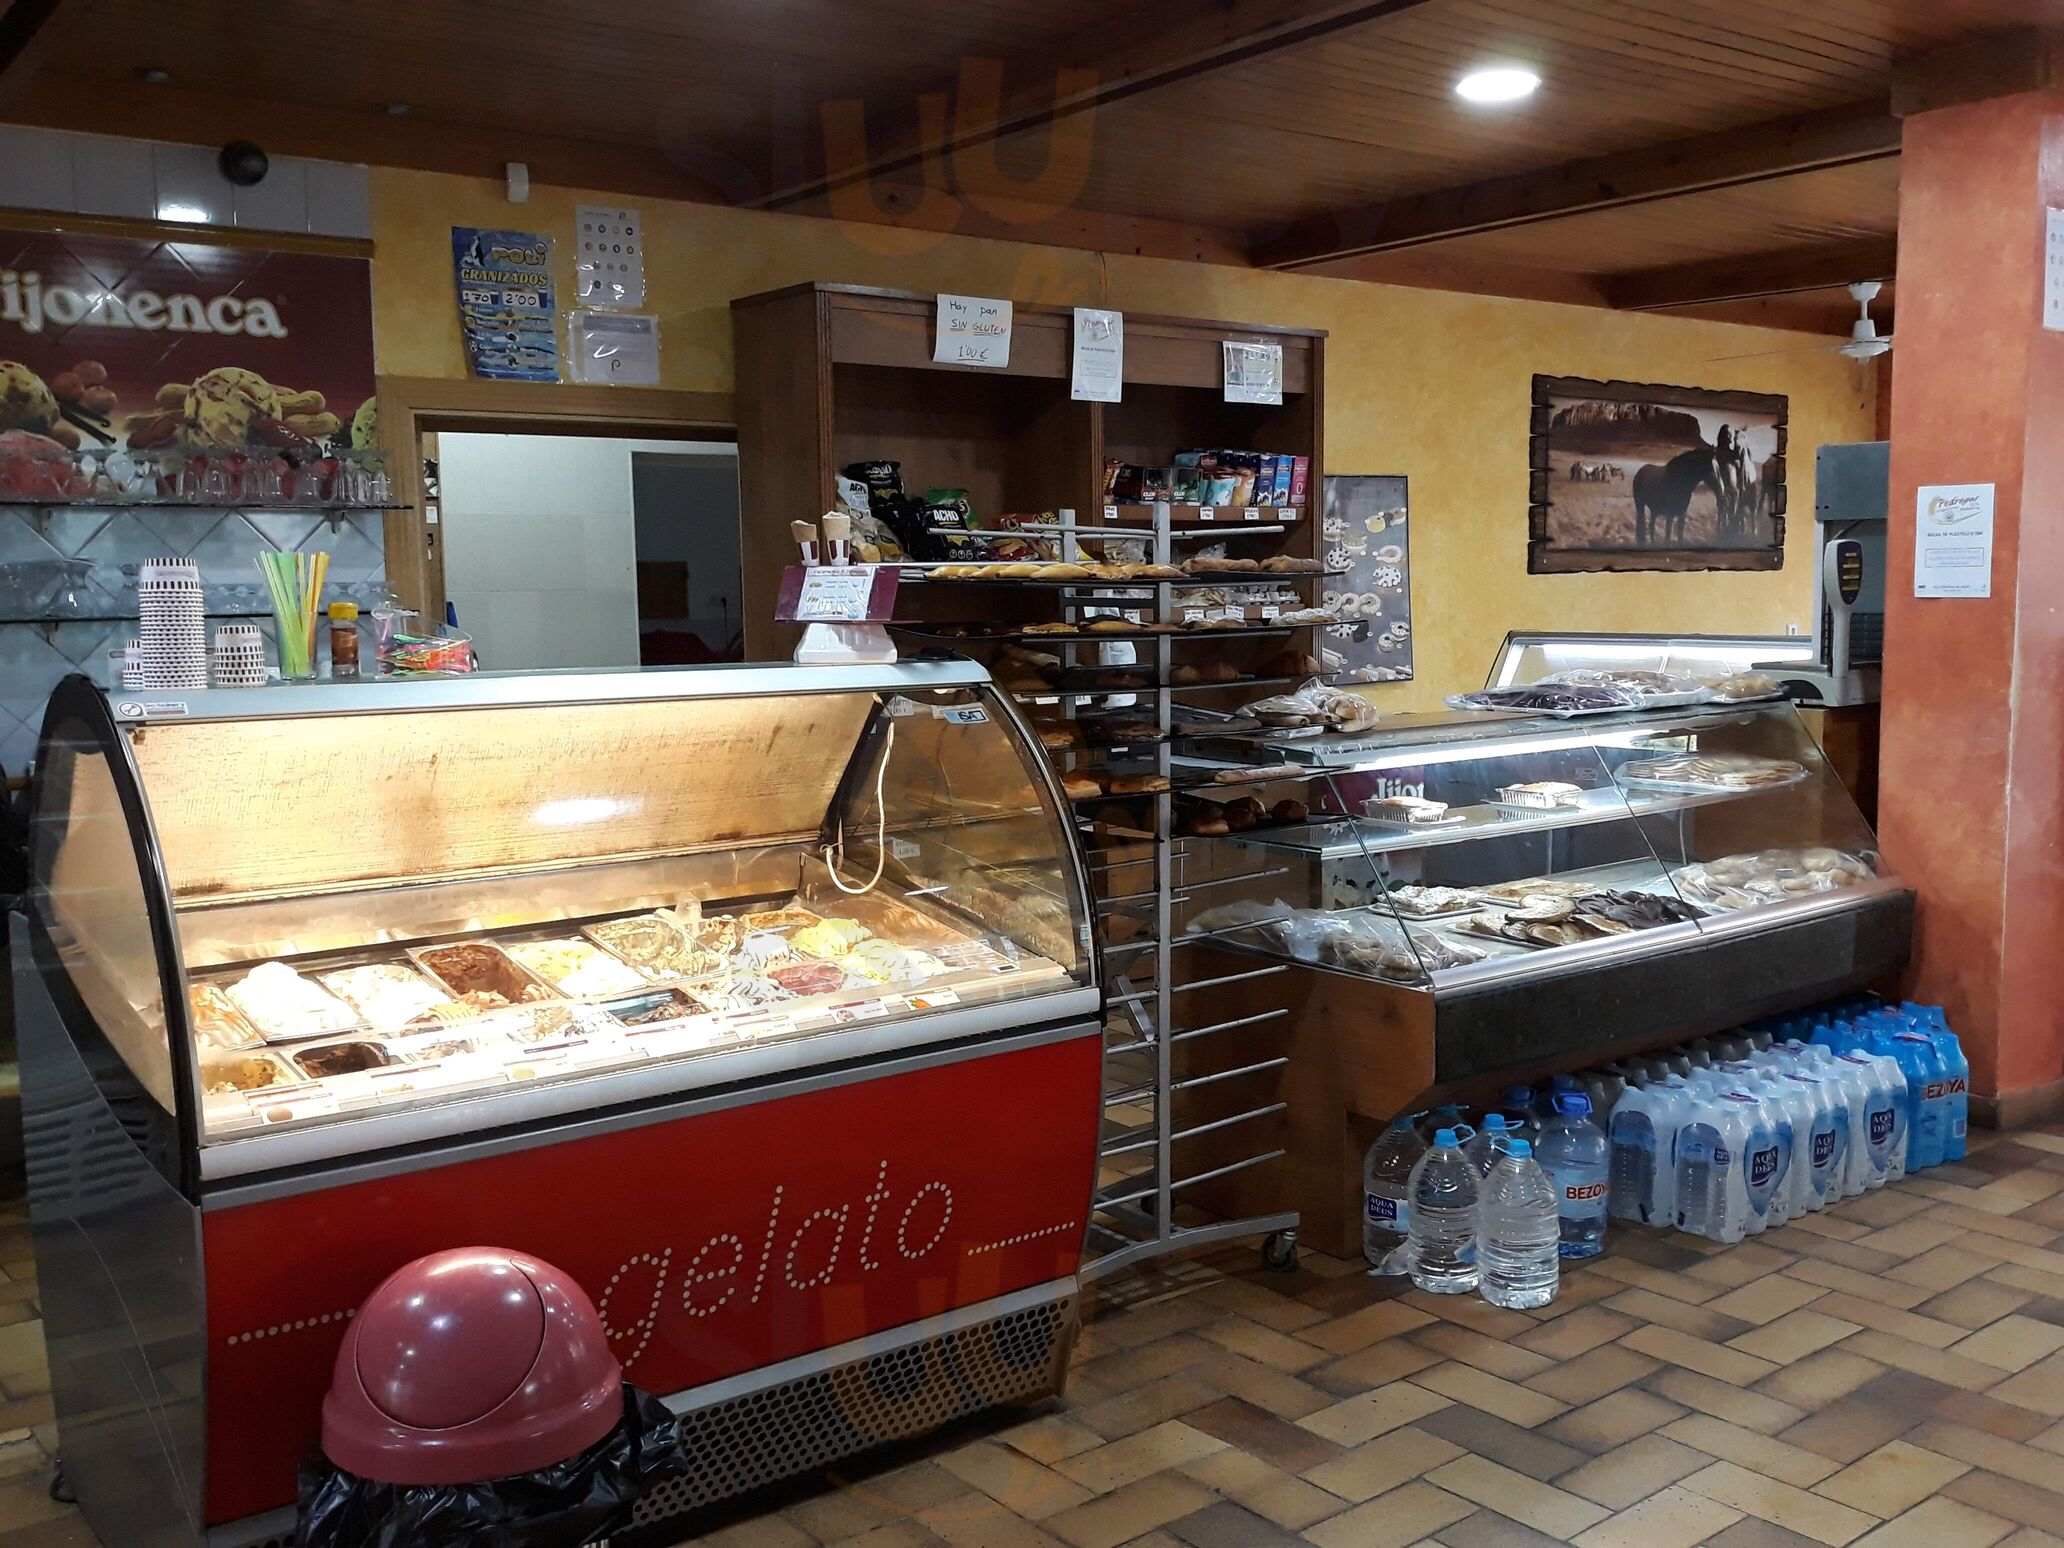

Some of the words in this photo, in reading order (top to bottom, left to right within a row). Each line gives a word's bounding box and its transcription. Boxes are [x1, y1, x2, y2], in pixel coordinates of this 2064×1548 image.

[460, 268, 549, 287] GRANIZADOS
[951, 319, 968, 329] SIN
[972, 322, 1007, 334] GLUTEN
[933, 509, 960, 522] ACHO
[598, 1159, 953, 1373] gelato
